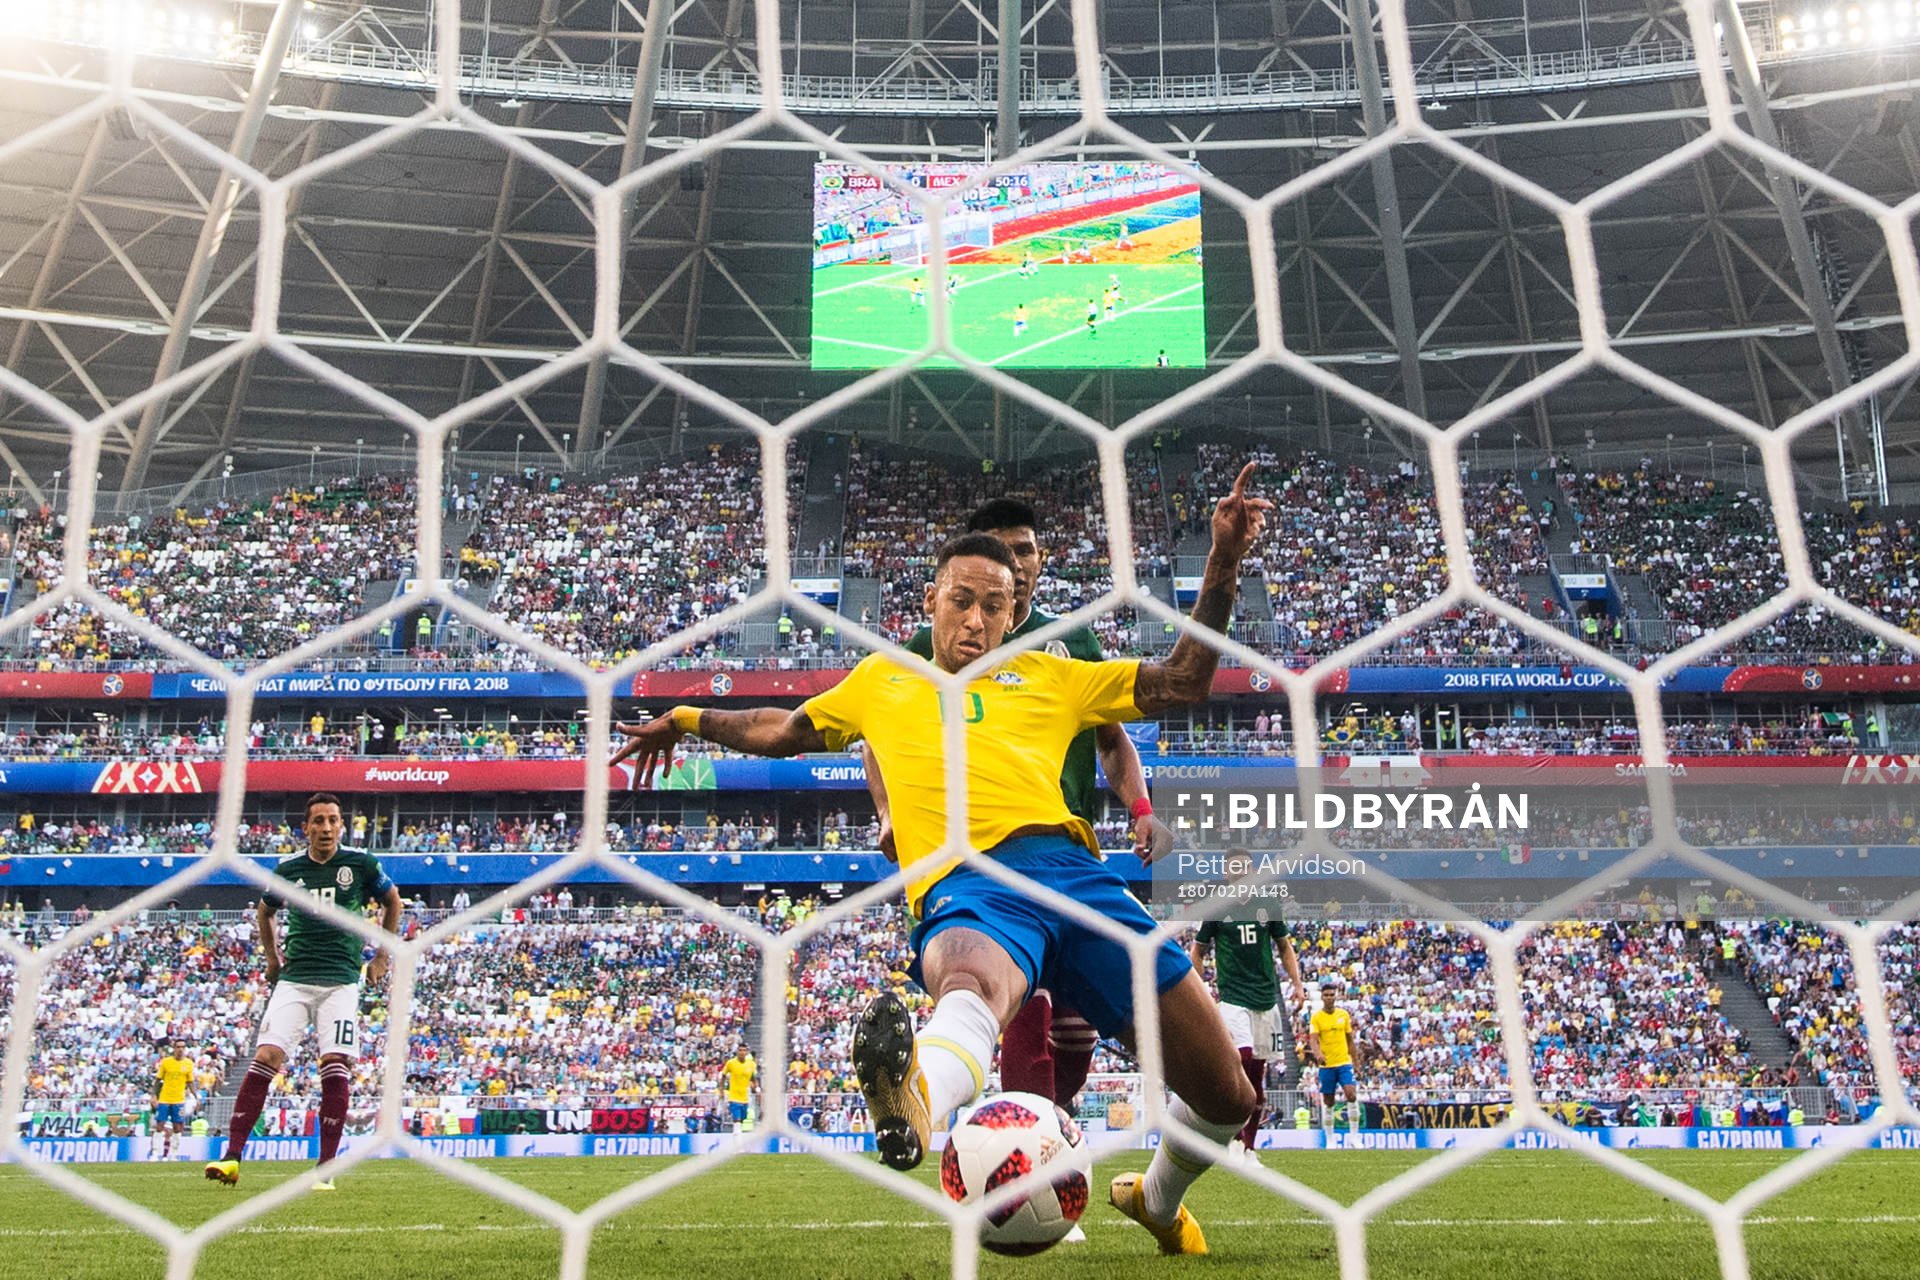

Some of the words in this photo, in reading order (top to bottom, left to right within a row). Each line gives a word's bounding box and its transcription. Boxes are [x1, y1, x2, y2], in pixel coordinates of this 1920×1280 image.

[848, 177, 877, 187] BRA
[933, 177, 959, 187] MEX
[995, 176, 1028, 187] 50:16
[191, 679, 286, 691] ЧЕМНАТ
[289, 679, 335, 691] МИРА
[338, 679, 360, 691] ПО
[363, 678, 435, 690] ФУТБОЛУ
[438, 677, 471, 690] FIFA
[473, 677, 509, 690] 2018
[1444, 673, 1479, 687] 2018
[1481, 673, 1514, 687] FIFA
[1573, 673, 1605, 687] CUP
[365, 767, 449, 785] #worldcup
[1156, 766, 1221, 779] РОССИИ
[1615, 763, 1688, 776] SAMRA
[1237, 924, 1257, 945] 16
[333, 1020, 355, 1046] 18
[481, 1110, 539, 1129] MAS
[546, 1109, 647, 1131] UNIDOS
[412, 1138, 496, 1158] AZPROM
[594, 1136, 680, 1156] GAZPROM
[778, 1135, 865, 1153] GAROM
[1334, 1131, 1416, 1149] GAPROM
[1514, 1131, 1599, 1149] GAZPM
[1697, 1129, 1783, 1149] GAZPROM
[29, 1141, 119, 1162] GAZPROM
[220, 1139, 309, 1161] GZPROM
